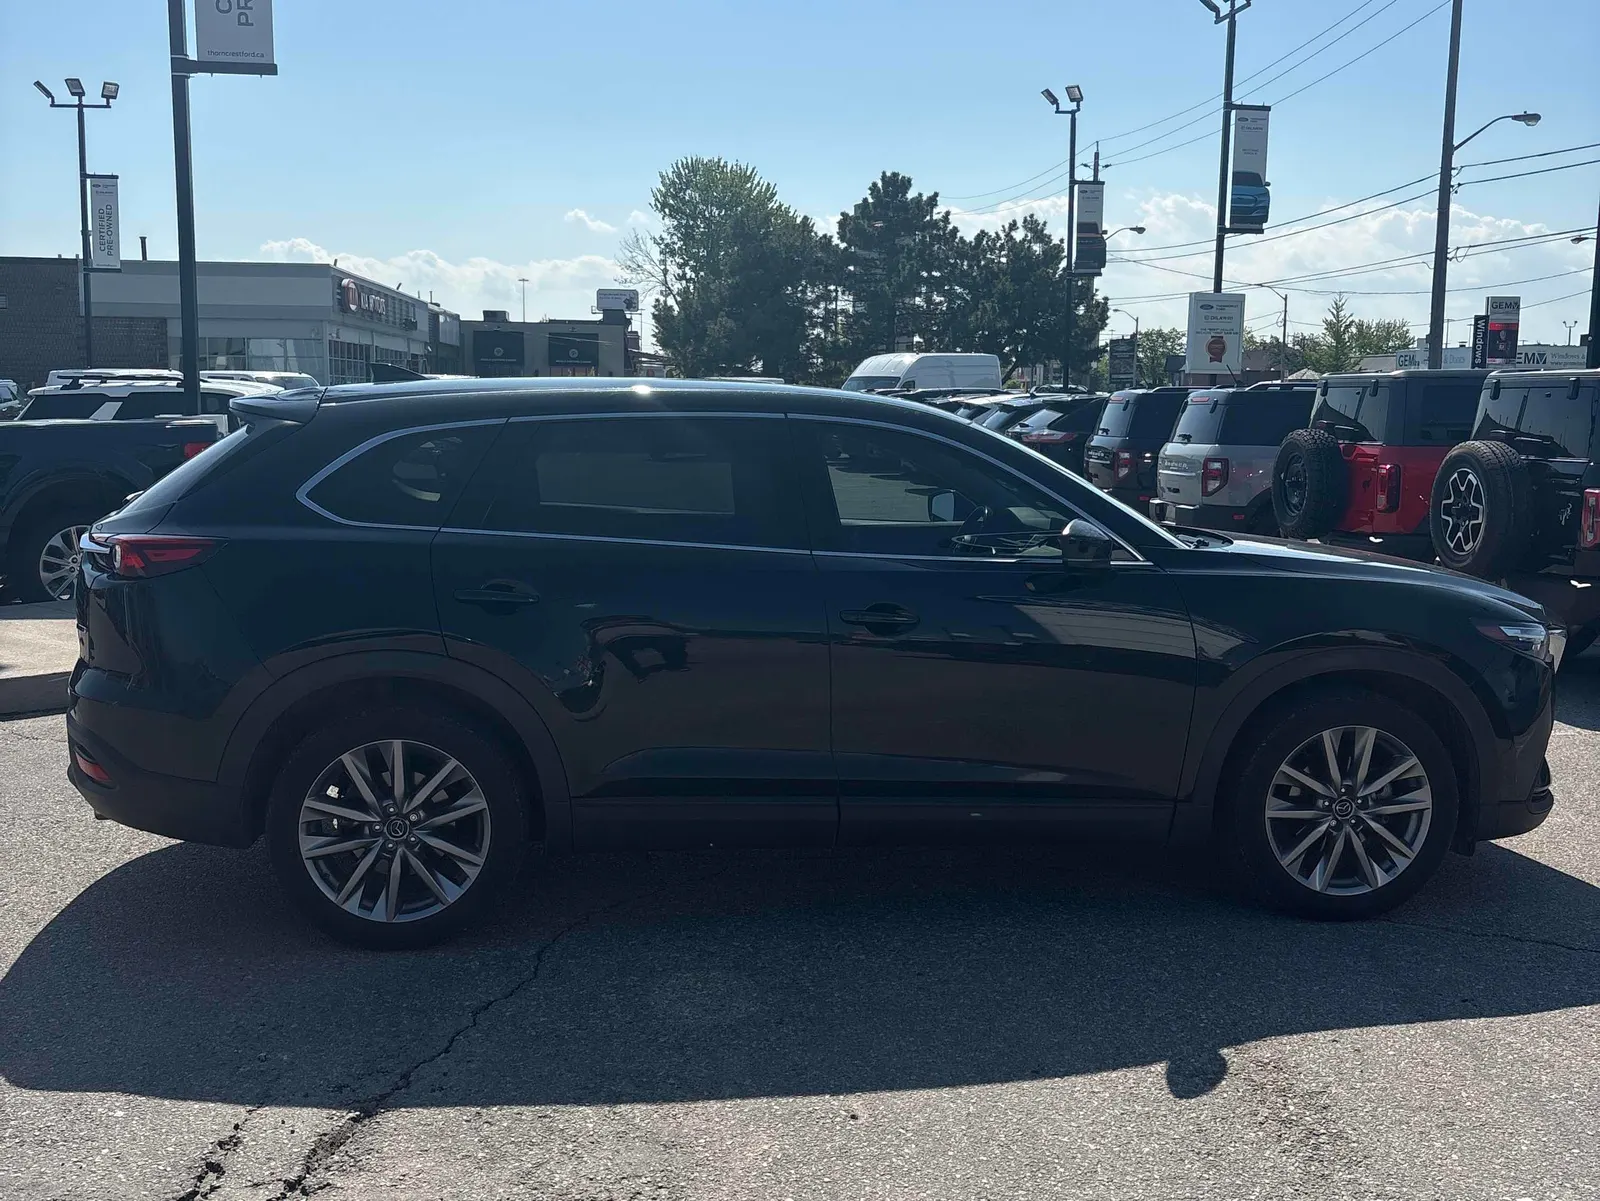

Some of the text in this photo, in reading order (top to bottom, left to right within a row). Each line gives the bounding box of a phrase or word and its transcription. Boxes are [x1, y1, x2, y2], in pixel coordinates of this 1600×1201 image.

[207, 50, 264, 58] thorncrestford.ca
[98, 207, 106, 252] CERTIFIED
[106, 204, 114, 256] PRE-OWNED
[1474, 319, 1485, 364] Windows
